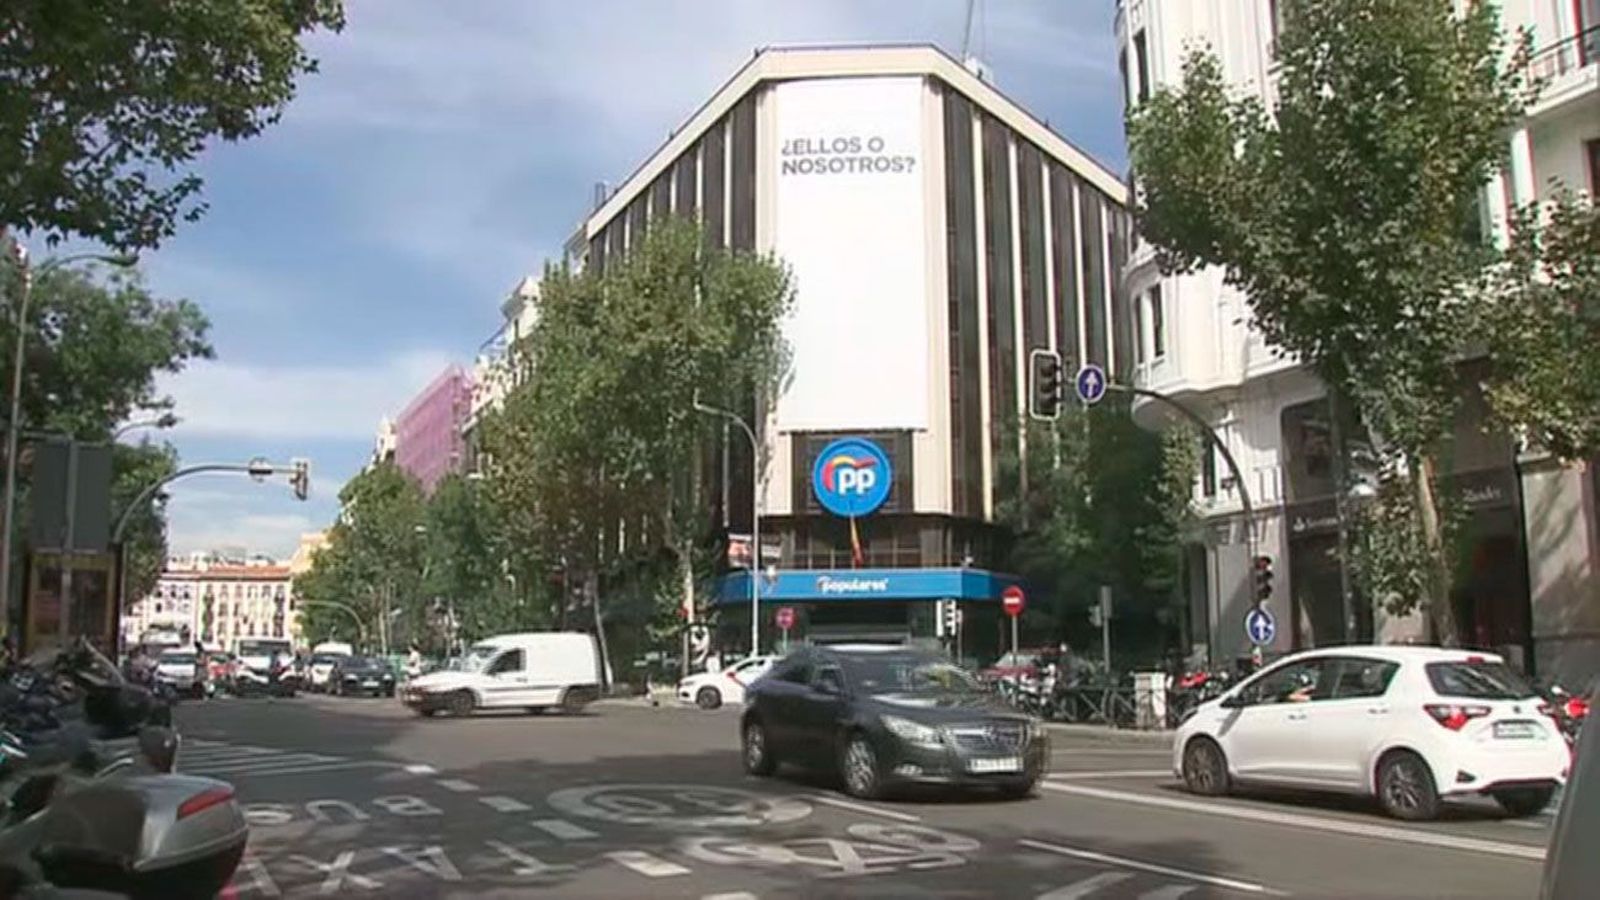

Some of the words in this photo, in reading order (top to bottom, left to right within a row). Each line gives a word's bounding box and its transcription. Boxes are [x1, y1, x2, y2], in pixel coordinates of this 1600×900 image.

[781, 136, 862, 156] ¿ELLOS
[867, 136, 885, 153] O
[781, 156, 916, 175] NOSOTROS?
